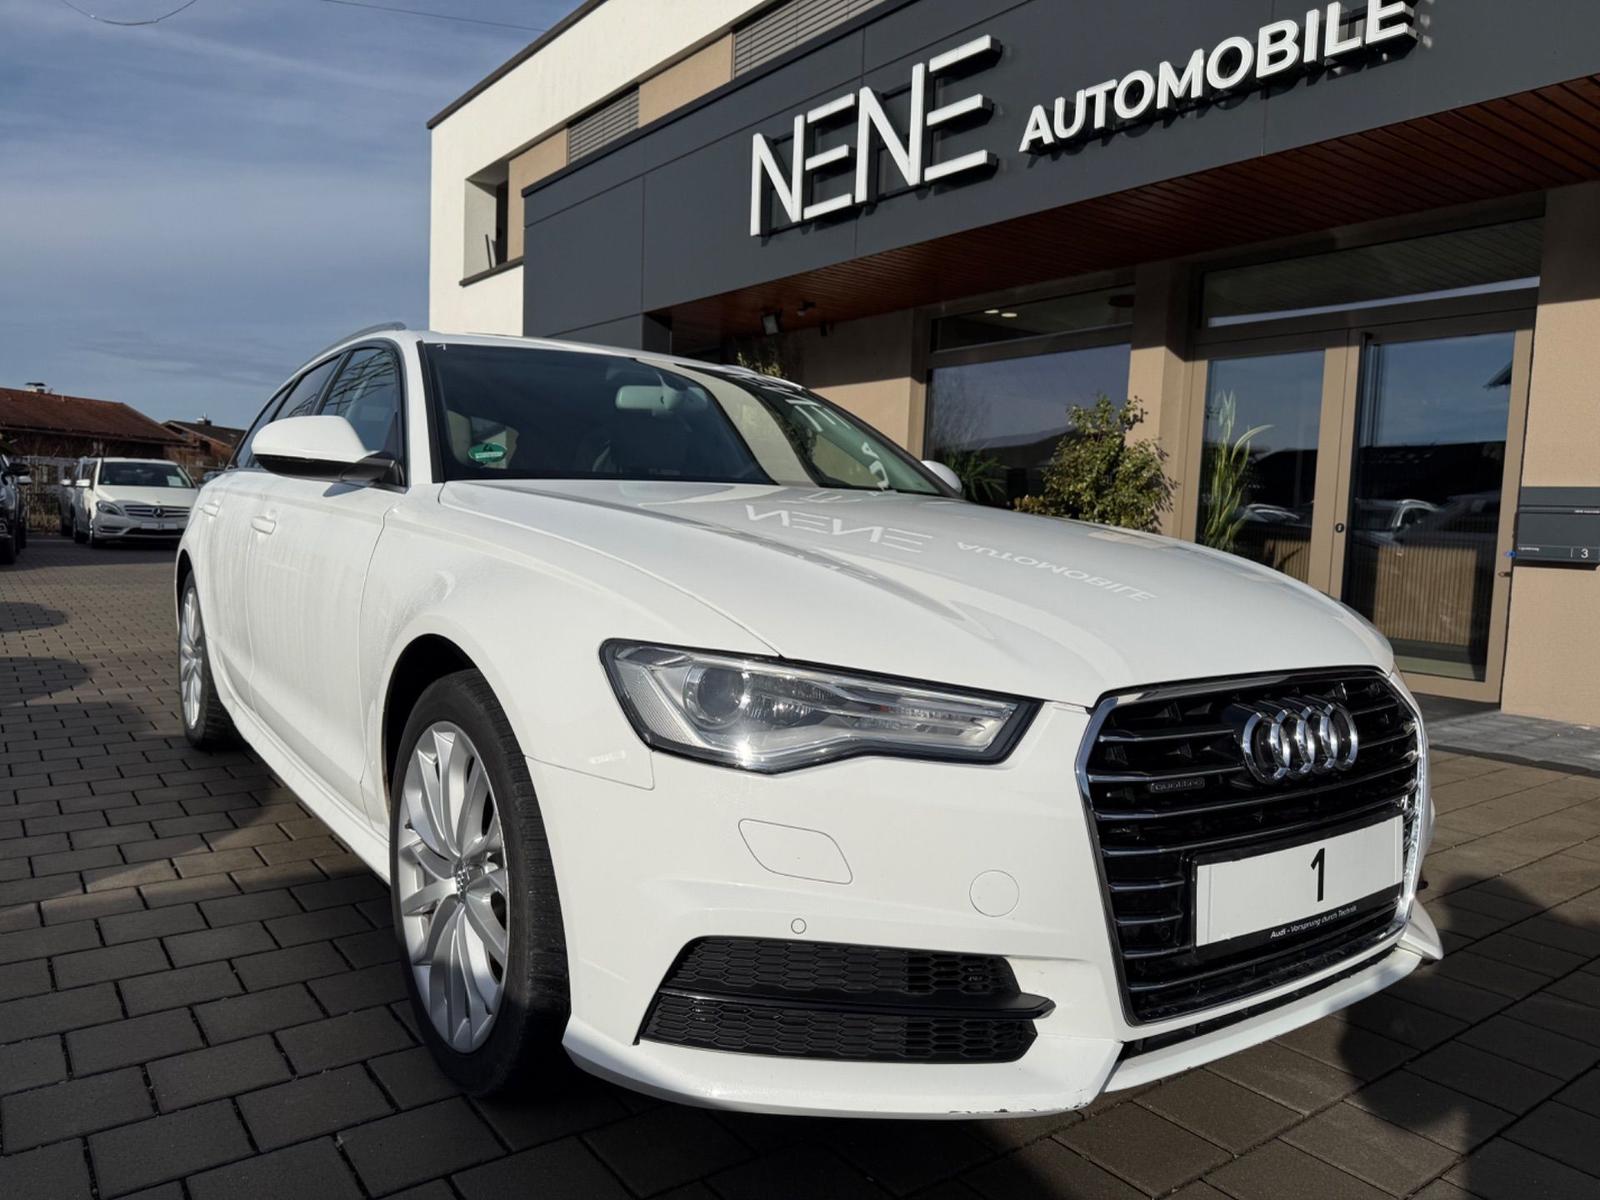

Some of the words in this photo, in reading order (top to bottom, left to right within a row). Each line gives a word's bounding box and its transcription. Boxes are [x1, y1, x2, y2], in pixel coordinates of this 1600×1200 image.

[750, 34, 994, 236] NENE
[1018, 0, 1410, 152] AUTOMOBILE
[1580, 547, 1589, 559] 3
[1310, 847, 1325, 902] 1
[1270, 928, 1286, 939] Audi
